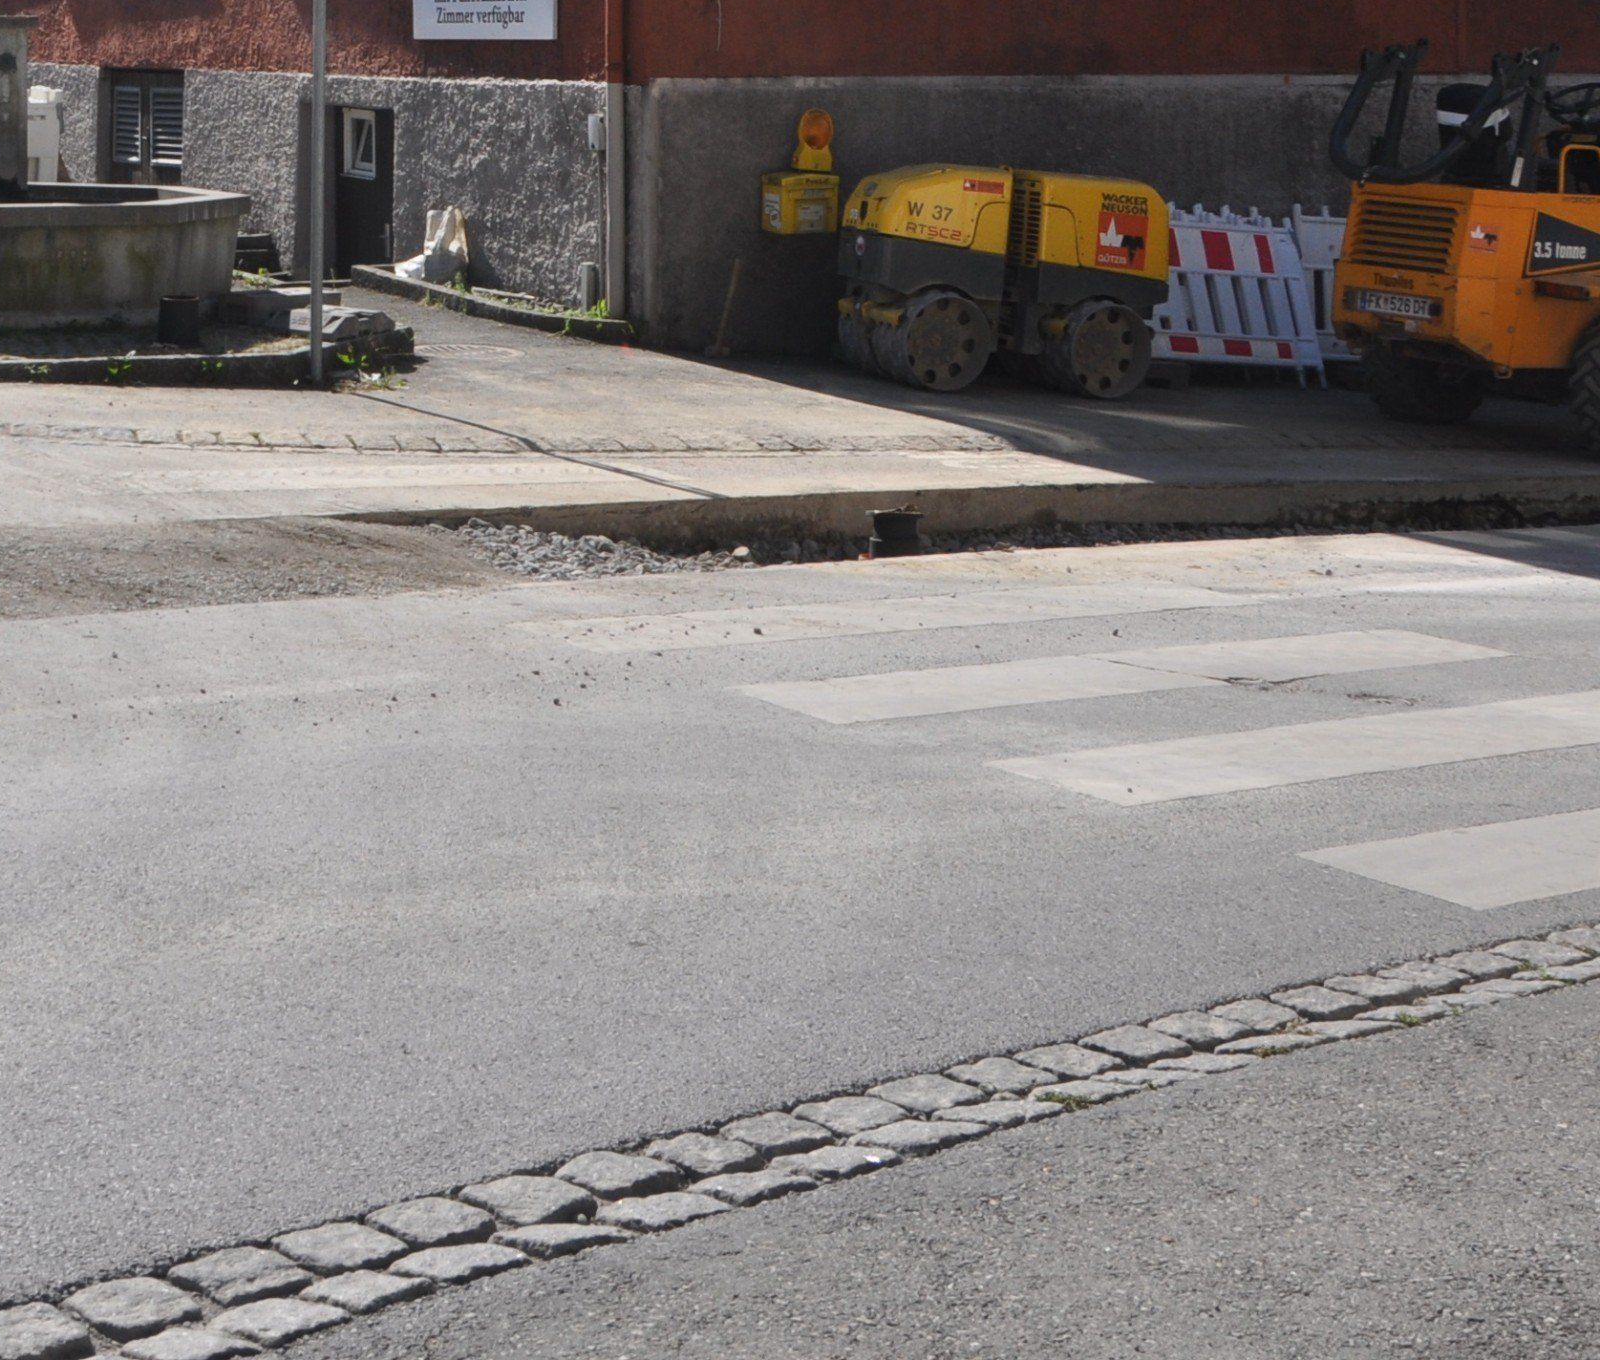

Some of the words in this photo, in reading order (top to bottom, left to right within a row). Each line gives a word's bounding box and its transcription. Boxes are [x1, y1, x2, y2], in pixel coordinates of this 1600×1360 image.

[436, 7, 475, 24] Zimmer
[476, 5, 525, 28] verfügbar
[1102, 192, 1148, 205] WACKER
[908, 201, 925, 218] W
[932, 204, 954, 222] 37
[1101, 202, 1148, 216] NEUSON
[1534, 242, 1553, 259] 3.5
[1555, 242, 1587, 260] tonne
[1367, 293, 1382, 309] FK
[1390, 295, 1412, 314] 526
